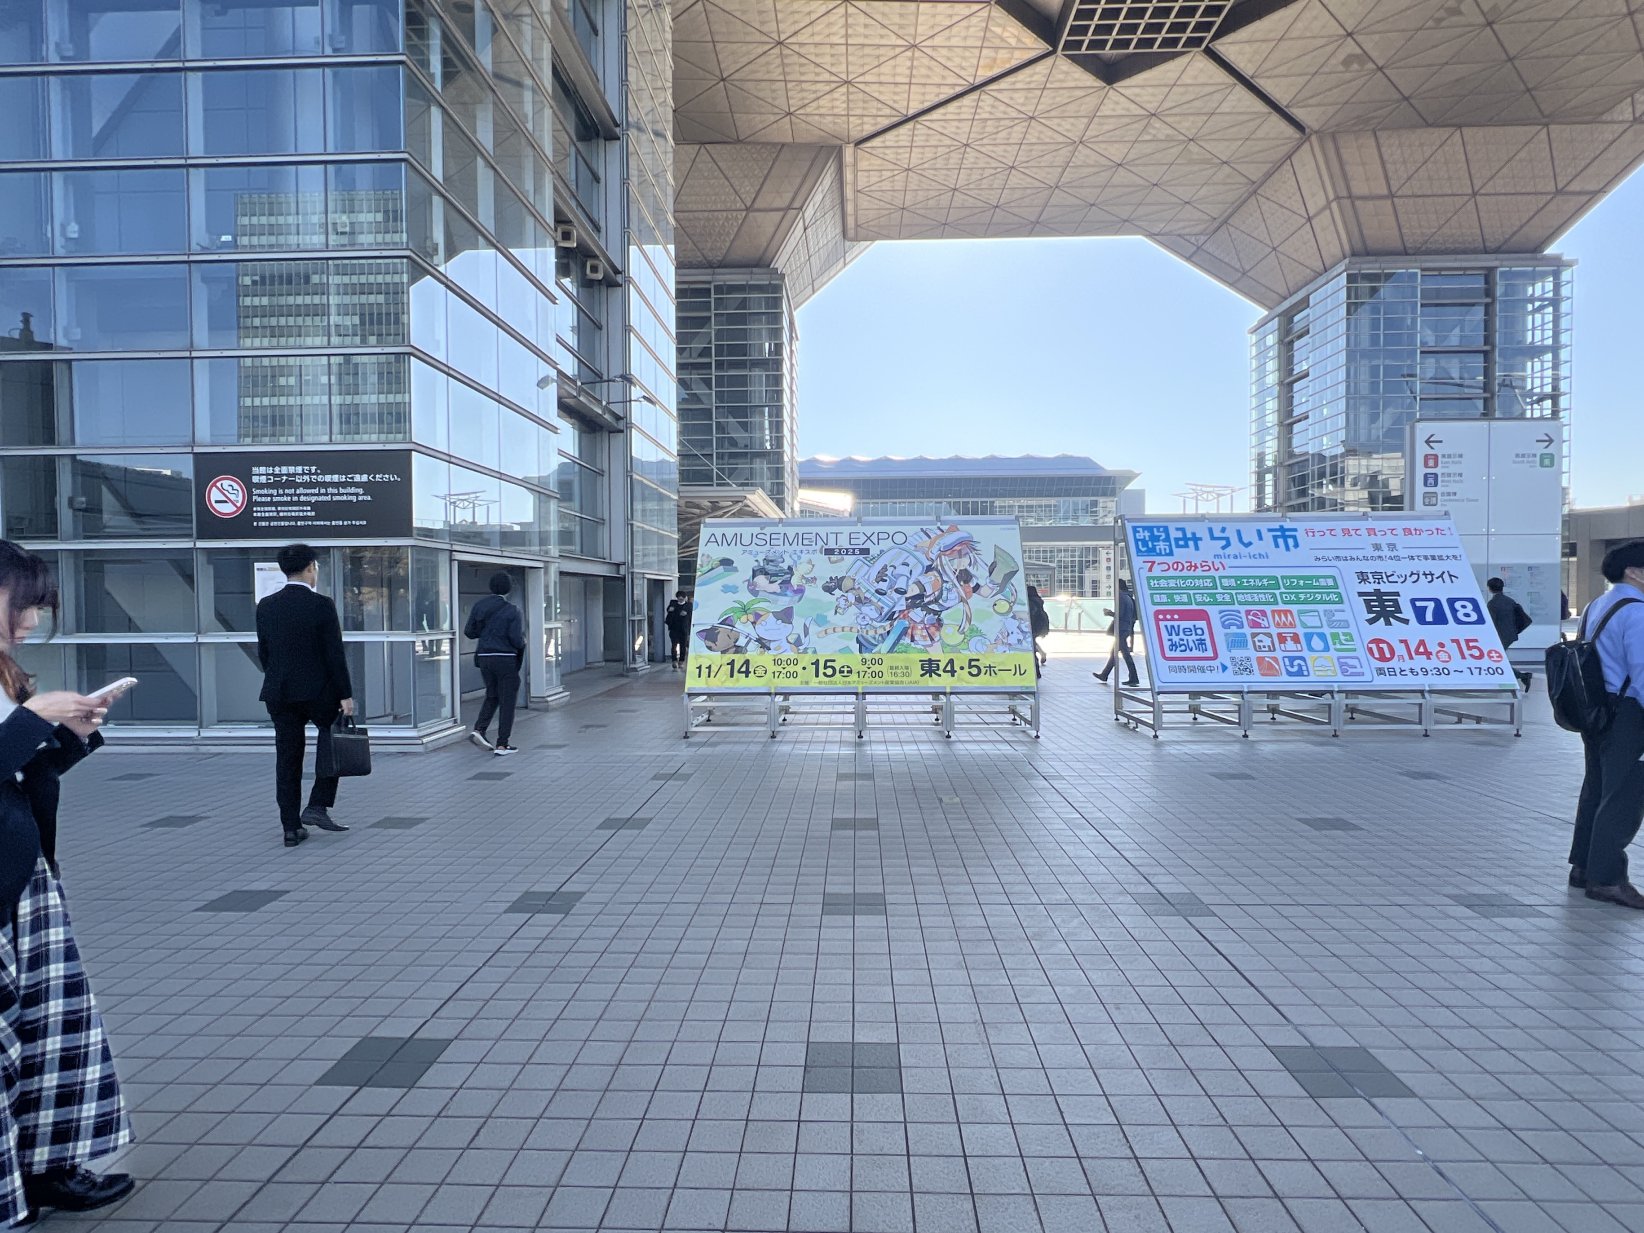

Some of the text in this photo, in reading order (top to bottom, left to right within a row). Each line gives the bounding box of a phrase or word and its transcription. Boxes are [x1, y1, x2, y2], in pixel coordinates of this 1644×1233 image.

[339, 487, 364, 495] building.
[1305, 528, 1336, 537] 行って
[1342, 528, 1362, 536] 見て
[1367, 528, 1398, 536] 買って
[705, 531, 908, 547] AMUSEMENT EXPO
[1174, 524, 1300, 552] みらい市
[1371, 542, 1398, 552] 東京
[1214, 552, 1269, 560] mirai-ichi
[1142, 560, 1226, 572] 7つのみらい
[1355, 571, 1459, 584] 東京ビッグサイト
[1300, 593, 1339, 602] デジタル化
[1357, 588, 1478, 626] 東 7 8
[1164, 624, 1204, 636] Web
[1168, 638, 1208, 654] みらい市
[772, 658, 798, 666] 10:00
[860, 658, 884, 666] 9:00
[772, 670, 798, 679] 17:00
[856, 670, 884, 679] 17:00
